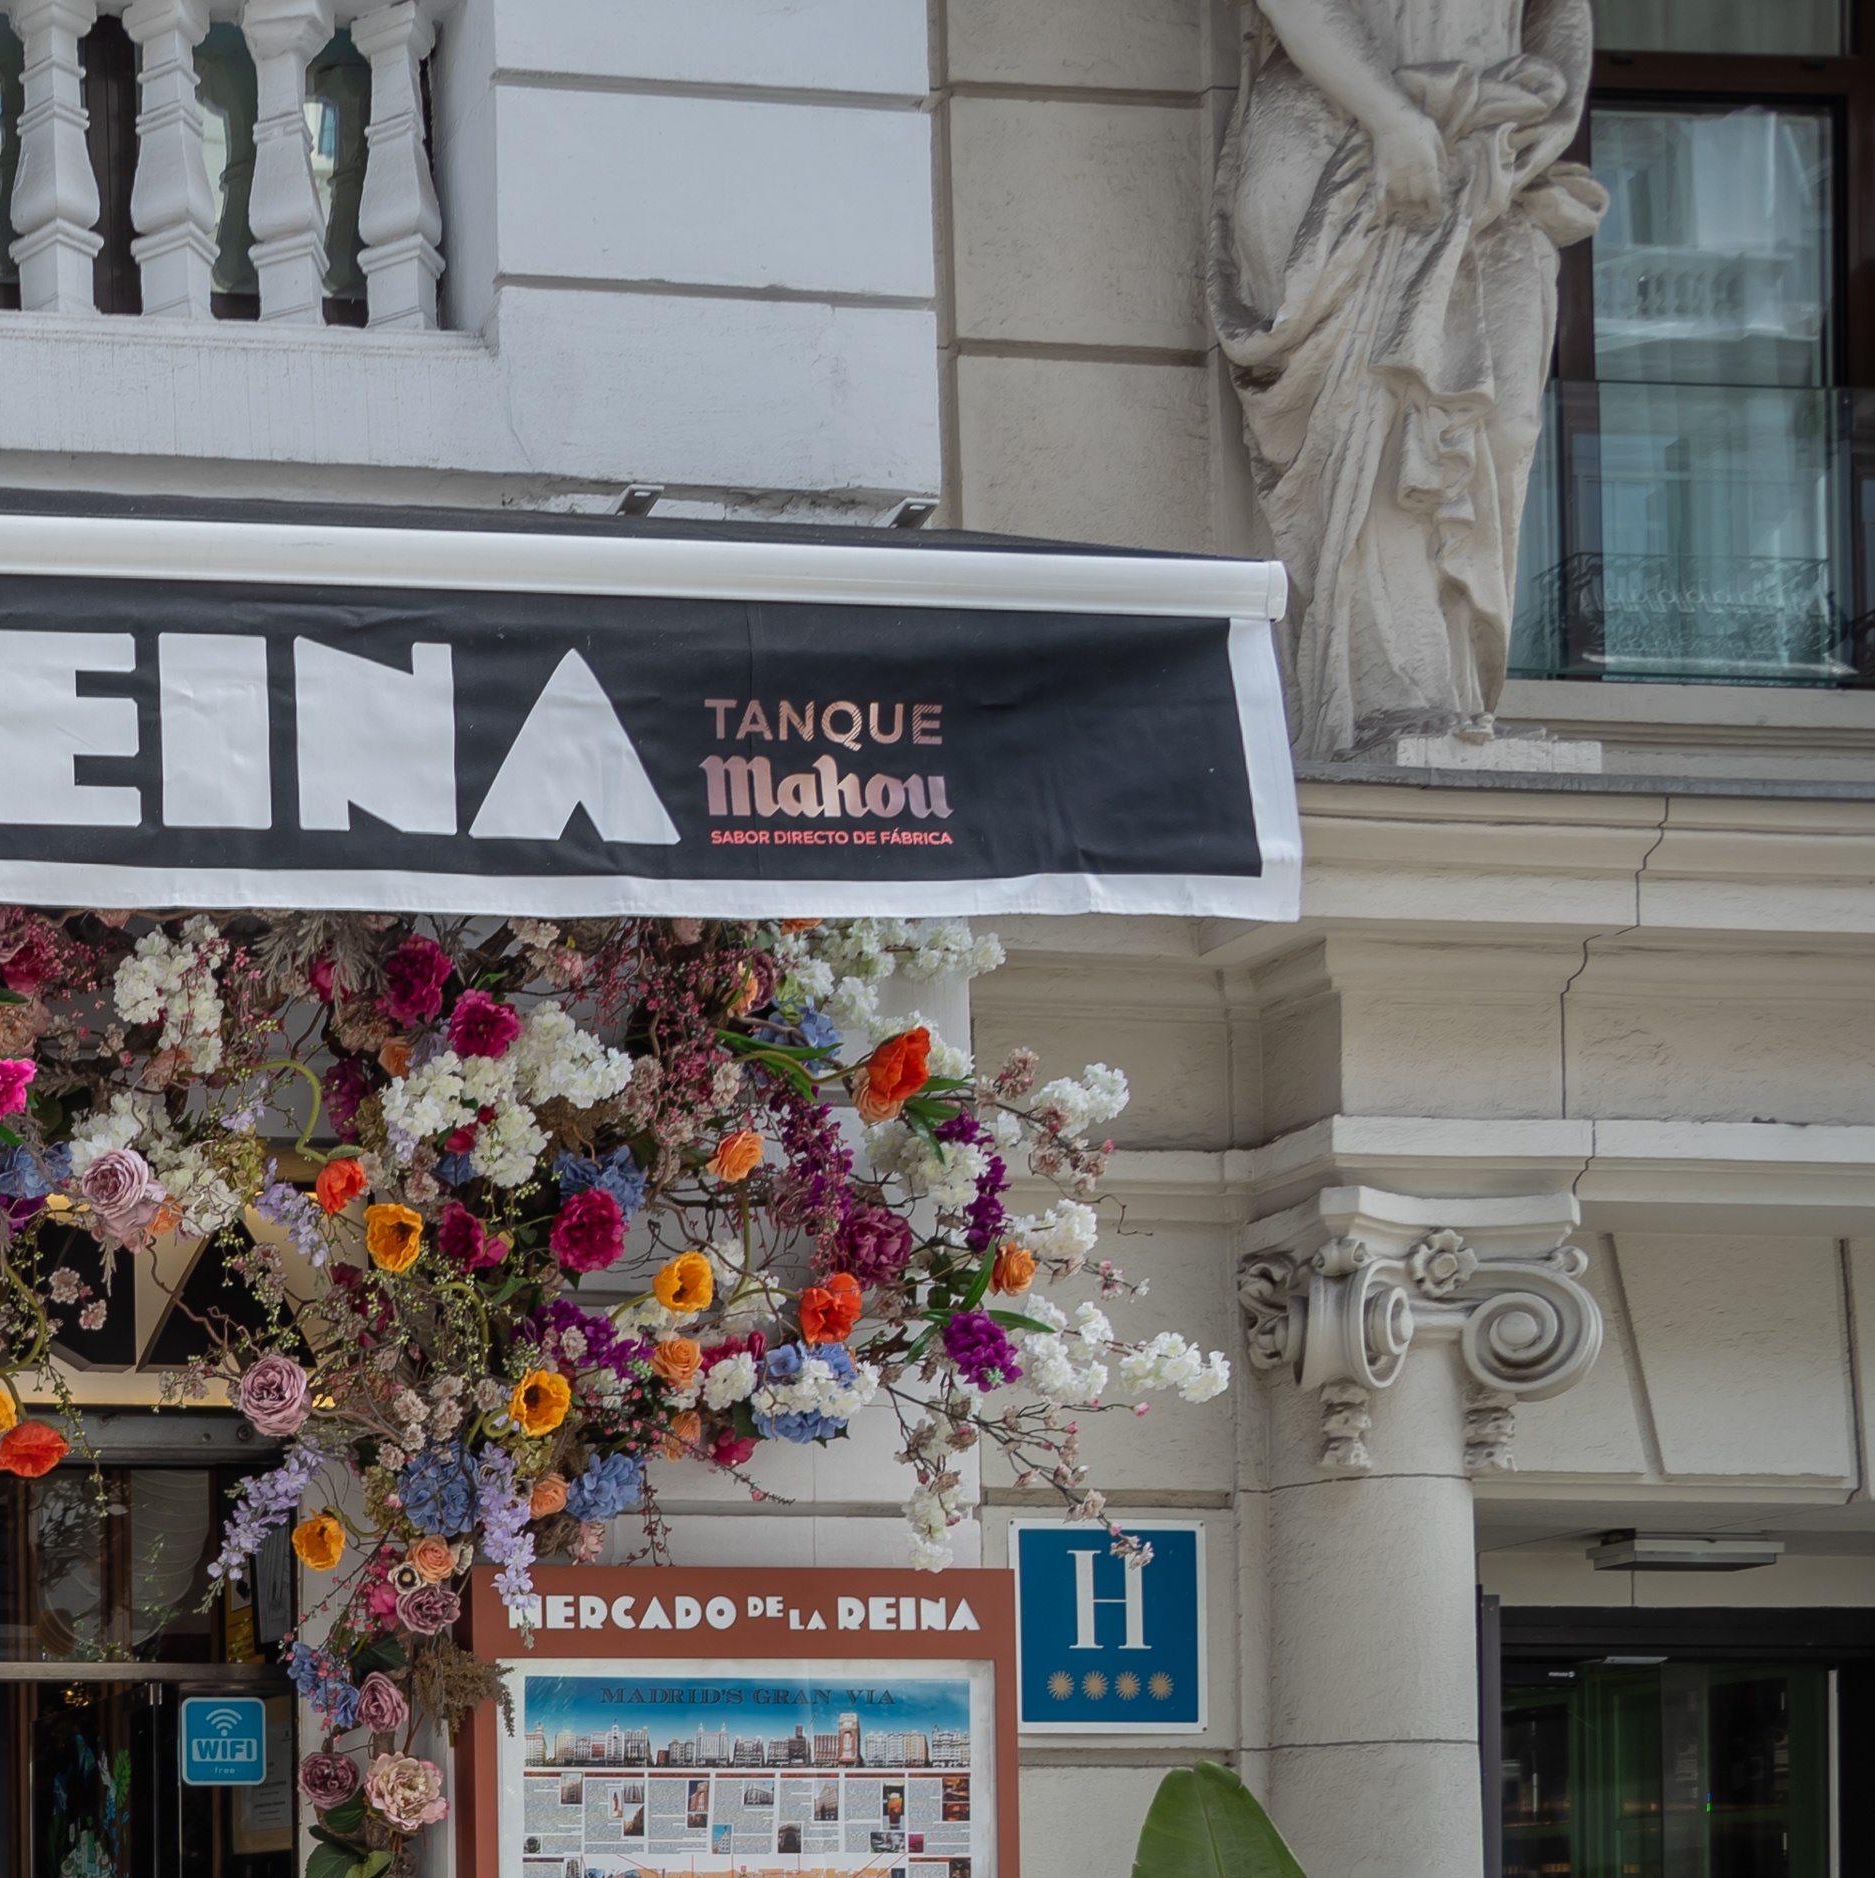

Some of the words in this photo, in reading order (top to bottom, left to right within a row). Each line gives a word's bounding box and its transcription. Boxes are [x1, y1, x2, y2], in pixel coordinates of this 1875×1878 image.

[704, 698, 943, 752] TANQUE
[699, 753, 954, 819] Mahou
[711, 830, 770, 845] SABOR
[774, 830, 849, 845] DIRECTO
[854, 831, 877, 845] DE
[880, 826, 954, 845] FÁBRICA
[508, 1595, 737, 1631] MERCADO
[748, 1596, 784, 1618] DE
[789, 1608, 828, 1631] LA
[837, 1596, 981, 1632] REINA
[1067, 1550, 1153, 1650] H
[600, 1686, 744, 1705] MADRID'S
[753, 1687, 832, 1705] GRAN
[846, 1687, 896, 1705] VIA
[197, 1740, 254, 1760] WIFI
[214, 1766, 236, 1774] free
